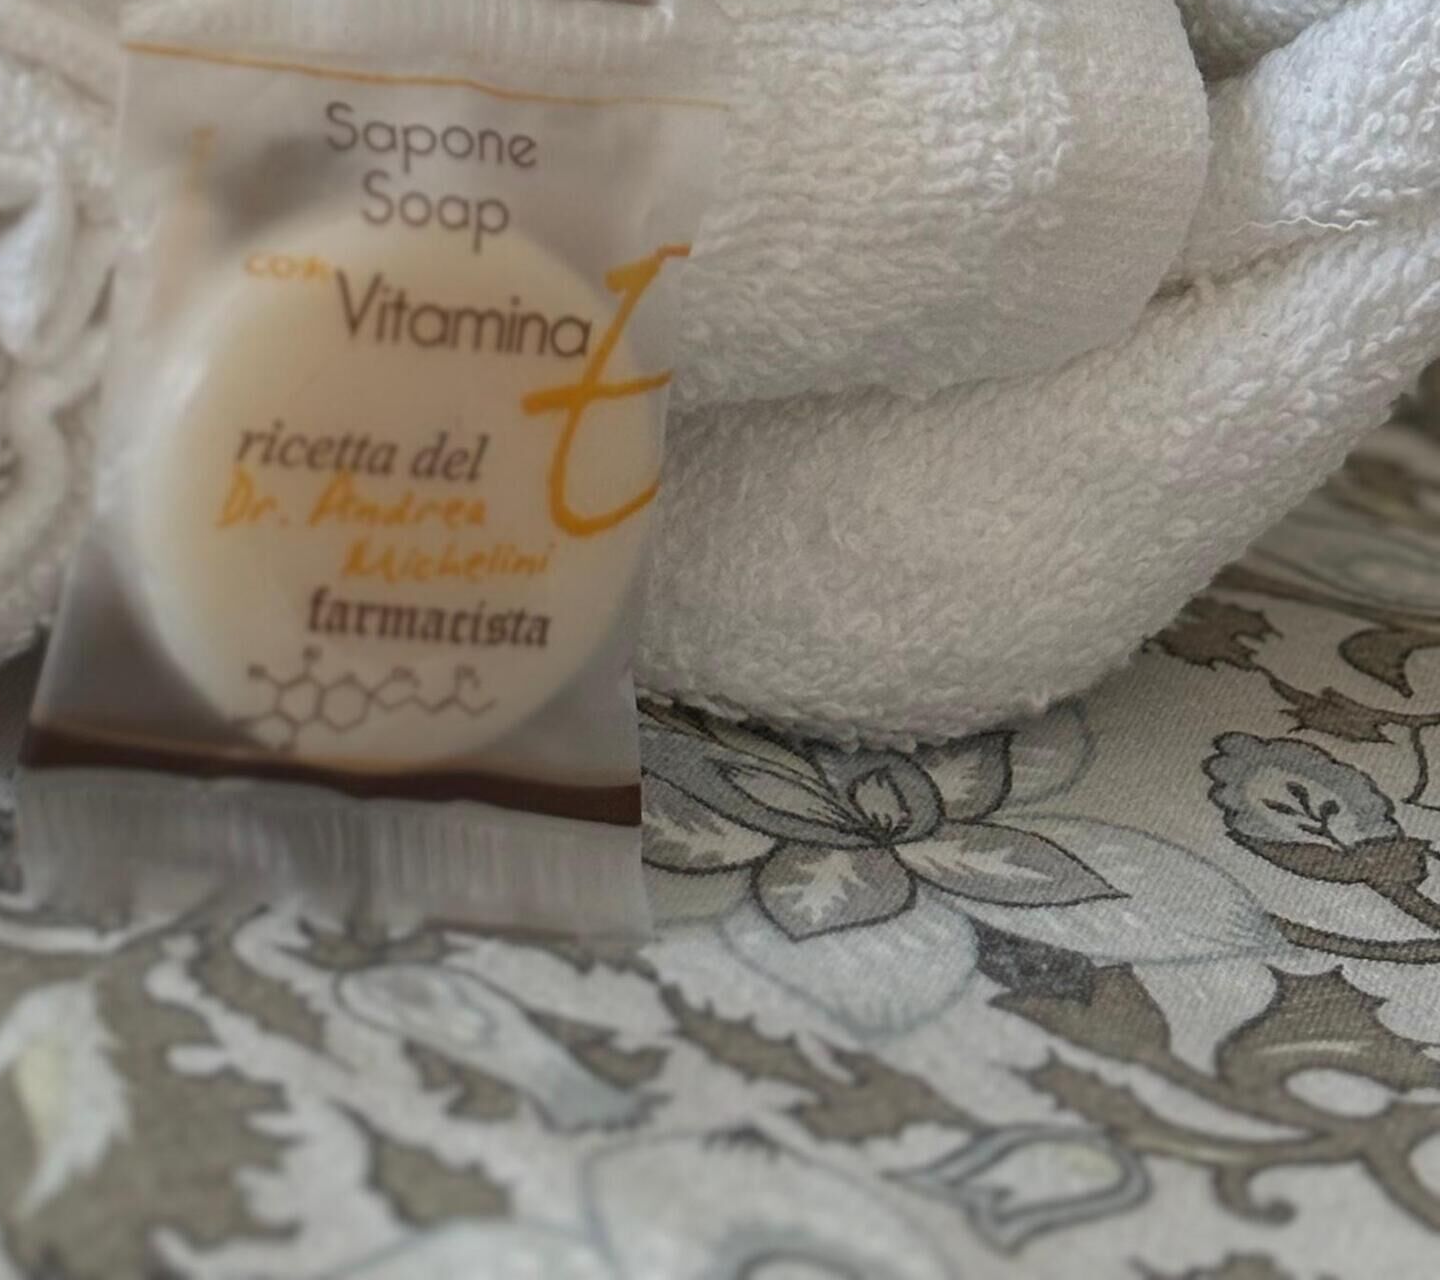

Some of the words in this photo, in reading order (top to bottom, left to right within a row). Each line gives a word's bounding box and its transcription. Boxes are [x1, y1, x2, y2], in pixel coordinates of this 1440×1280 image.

[326, 101, 538, 174] Sapone
[361, 169, 510, 255] Soap
[331, 267, 594, 360] Vitamina
[237, 420, 394, 478] ricetta
[410, 433, 488, 483] del
[217, 470, 289, 530] Dr.
[309, 470, 486, 530] Andrea
[342, 540, 553, 583] Michelini
[309, 587, 552, 650] farmacista
